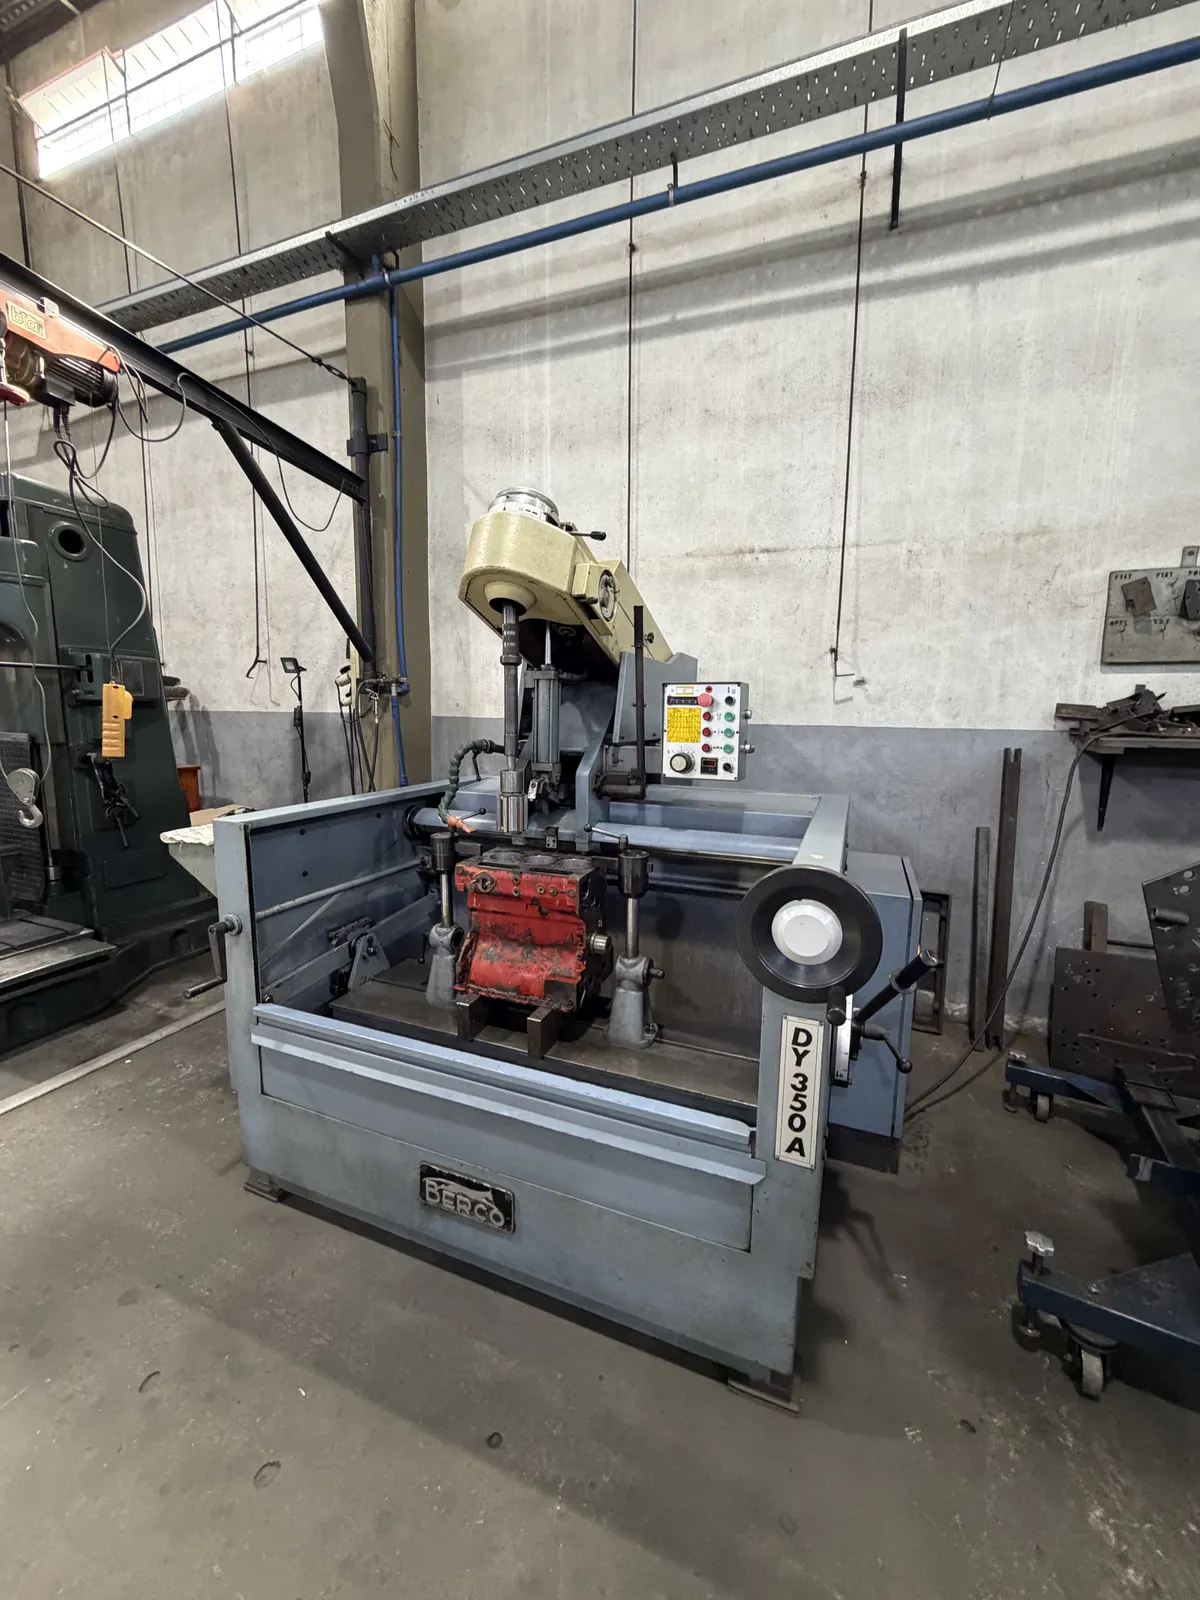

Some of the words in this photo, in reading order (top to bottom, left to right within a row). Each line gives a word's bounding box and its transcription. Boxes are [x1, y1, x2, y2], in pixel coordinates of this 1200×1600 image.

[791, 1027, 813, 1067] DY
[787, 1073, 809, 1132] 350
[784, 1137, 806, 1158] A
[424, 1179, 505, 1227] BERCO
